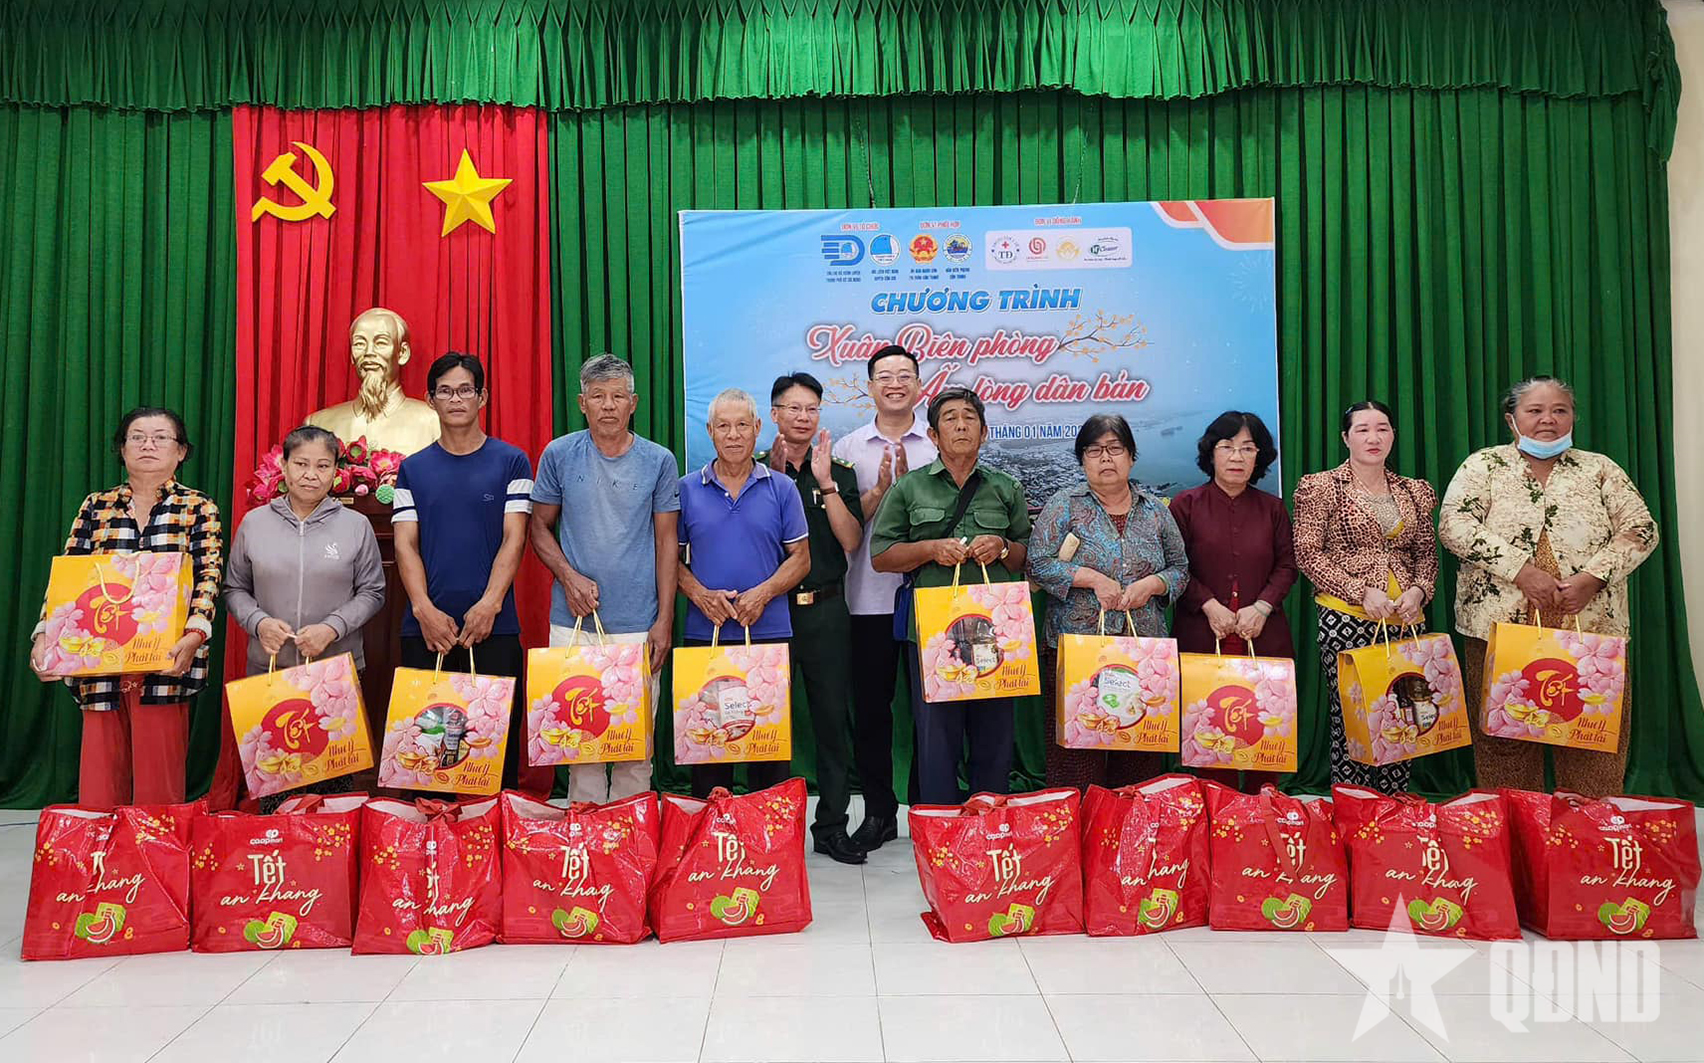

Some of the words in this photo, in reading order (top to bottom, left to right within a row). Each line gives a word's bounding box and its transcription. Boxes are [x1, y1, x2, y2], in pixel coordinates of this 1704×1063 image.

[870, 286, 991, 314] CHƯƠNG
[1000, 283, 1082, 311] TRÌNH
[897, 323, 969, 362] Biên
[969, 330, 1057, 365] phòng
[973, 376, 1028, 410] lòng
[1034, 373, 1090, 402] dân
[1091, 369, 1148, 401] bản
[990, 423, 1022, 439] THÁNG
[1040, 423, 1062, 438] NĂM
[1065, 425, 1082, 438] 20
[724, 701, 749, 710] Selec
[985, 842, 1022, 882] Tết
[1603, 834, 1643, 869] Tết
[246, 849, 287, 886] Tết
[688, 871, 716, 882] an
[720, 860, 780, 892] khang
[1121, 875, 1147, 887] an
[1241, 867, 1272, 878] an
[1385, 868, 1416, 880] an
[56, 891, 86, 903] an
[532, 879, 556, 892] an
[965, 892, 993, 904] an
[996, 878, 1054, 906] khang
[1580, 875, 1608, 885] an
[1612, 868, 1677, 907] khang
[220, 894, 250, 906] an
[255, 883, 323, 918] khang
[392, 898, 421, 910] an
